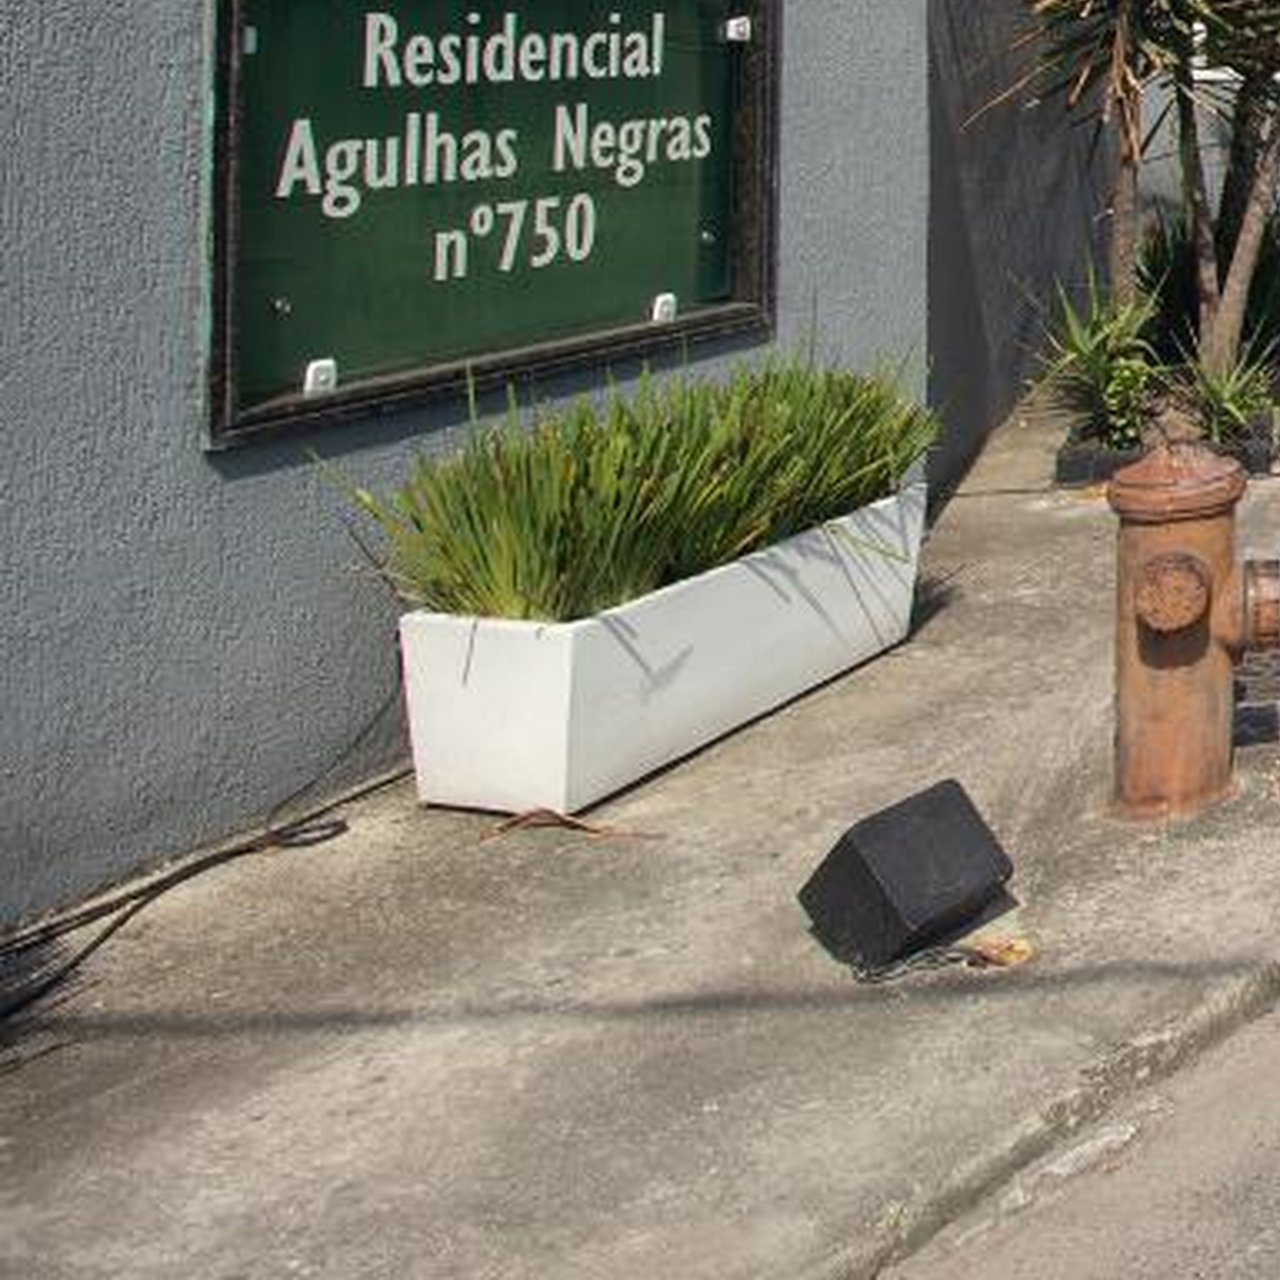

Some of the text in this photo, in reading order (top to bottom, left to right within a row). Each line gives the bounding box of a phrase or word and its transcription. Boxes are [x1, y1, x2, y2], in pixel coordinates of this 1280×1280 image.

[363, 12, 665, 87] Residencial
[275, 102, 712, 218] Agulhas Negras
